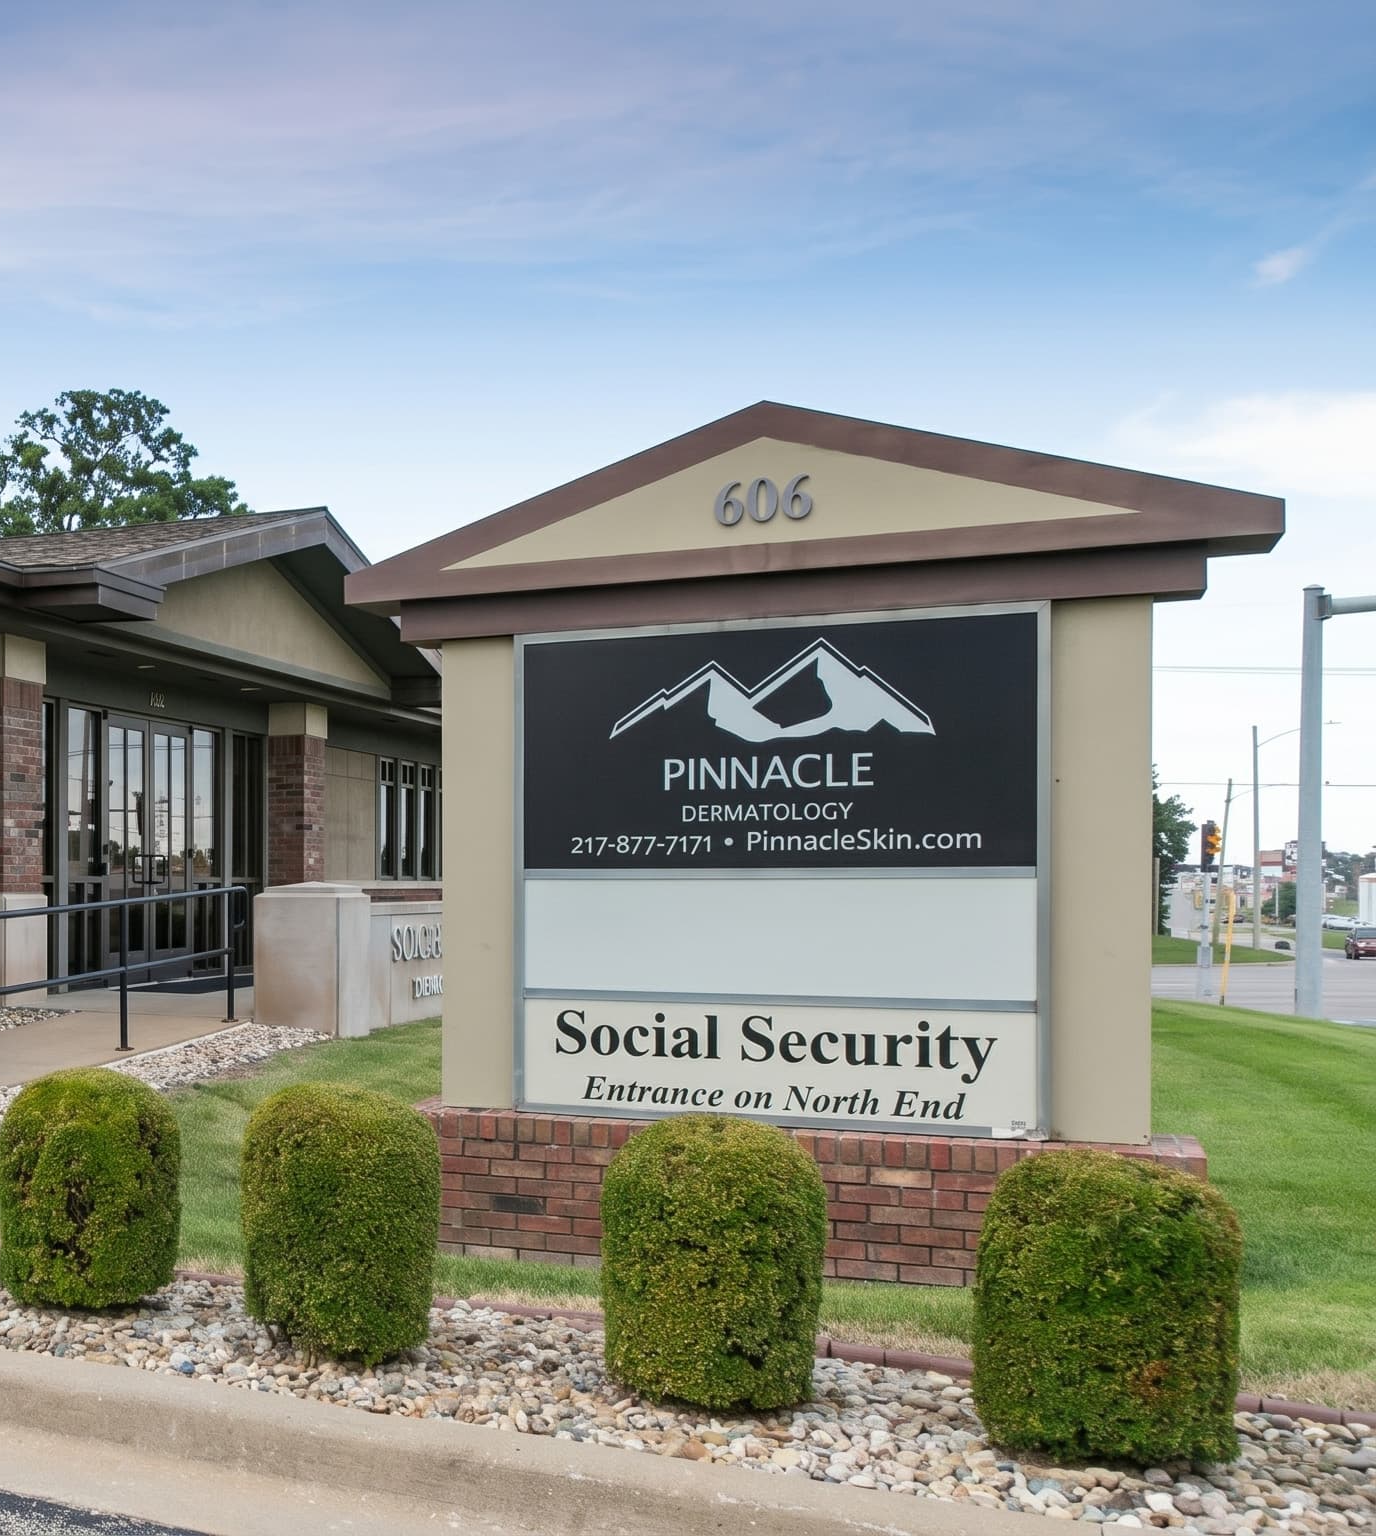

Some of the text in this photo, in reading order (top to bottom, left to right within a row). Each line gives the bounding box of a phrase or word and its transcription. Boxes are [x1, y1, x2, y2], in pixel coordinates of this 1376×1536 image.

[714, 472, 813, 527] 606
[664, 752, 874, 791] PINNACLE
[682, 801, 854, 823] DERMATOLOGY
[571, 827, 982, 857] 217-877-7171 PinnacleSkin.com
[555, 1009, 998, 1084] Social Security
[582, 1075, 966, 1120] Entrance on North End
